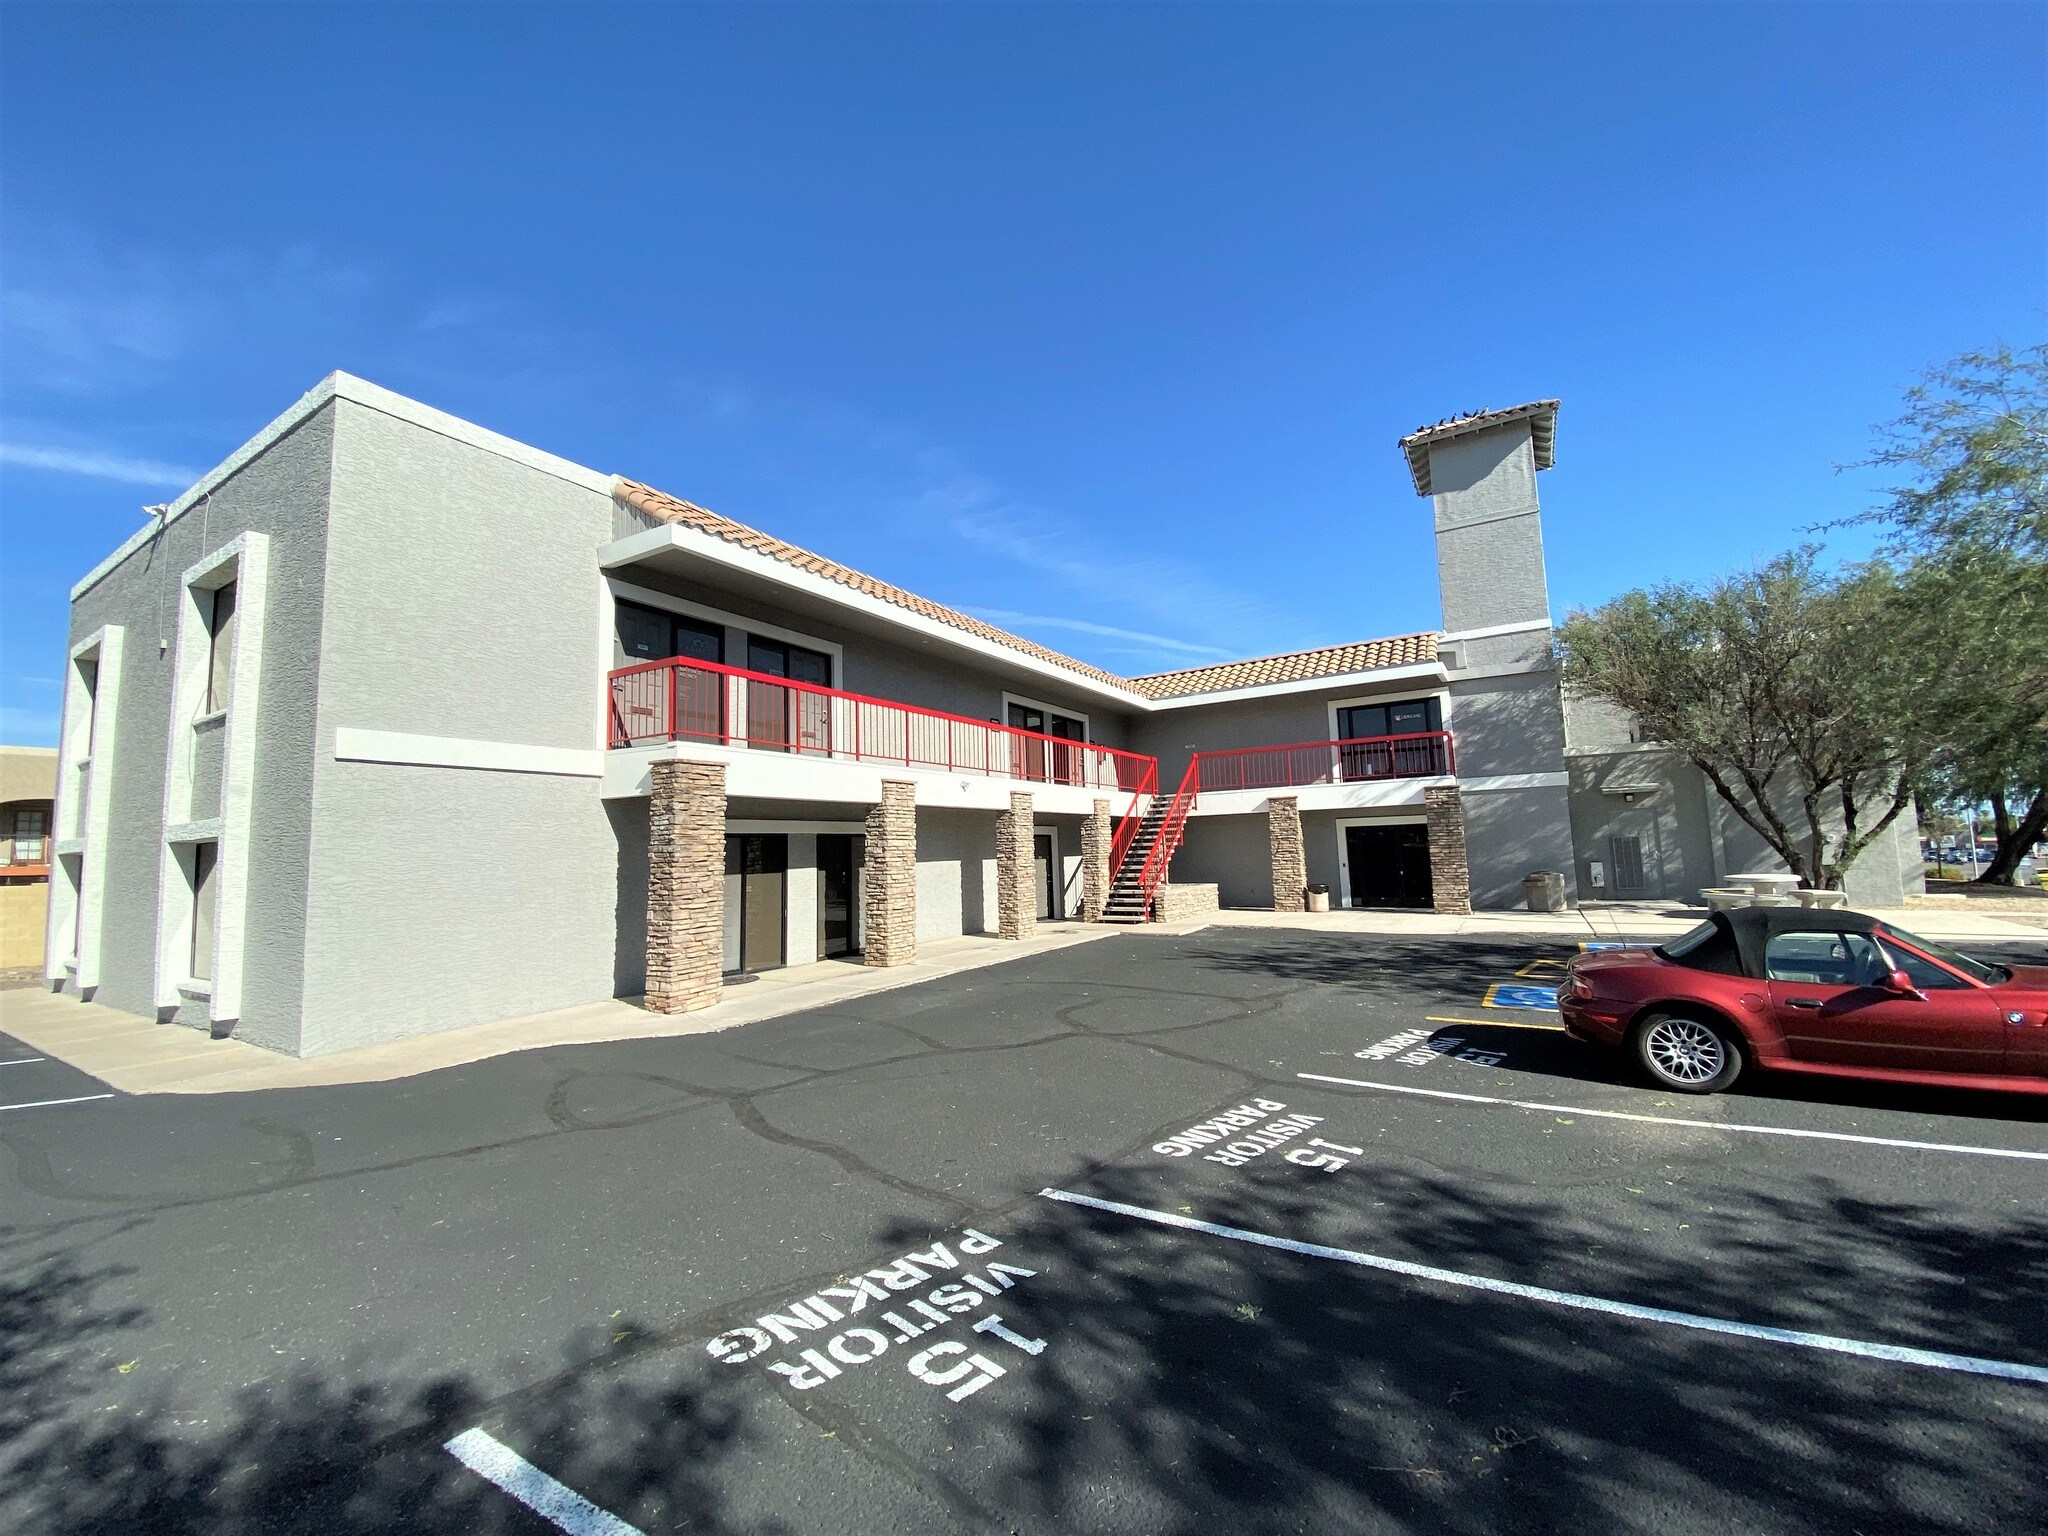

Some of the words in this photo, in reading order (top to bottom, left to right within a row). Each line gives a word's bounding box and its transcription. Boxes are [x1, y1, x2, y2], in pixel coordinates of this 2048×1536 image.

[1354, 1028, 1434, 1061] PARKING
[1152, 1098, 1287, 1157] PARKING
[1203, 1113, 1325, 1167] VISITOR
[1285, 1138, 1364, 1173] 15
[706, 1228, 1003, 1364] PARKING
[767, 1262, 1038, 1390] VISITOR
[907, 1313, 1048, 1403] 15
